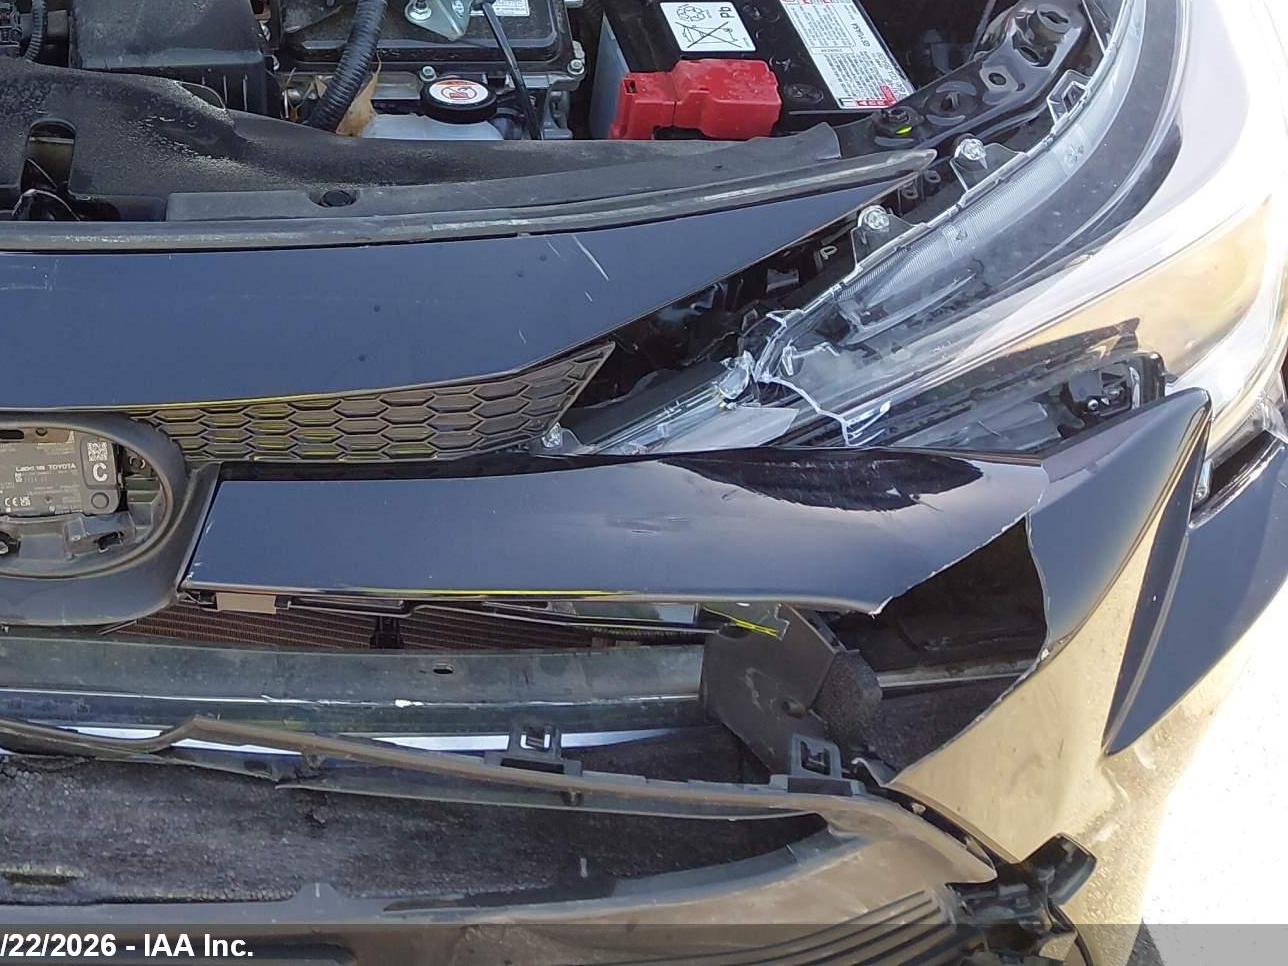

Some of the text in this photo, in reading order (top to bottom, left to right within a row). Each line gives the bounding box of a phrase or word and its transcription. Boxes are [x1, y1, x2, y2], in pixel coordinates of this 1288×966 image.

[718, 6, 736, 18] Pb
[48, 462, 76, 471] TOYOTA
[93, 462, 108, 482] C
